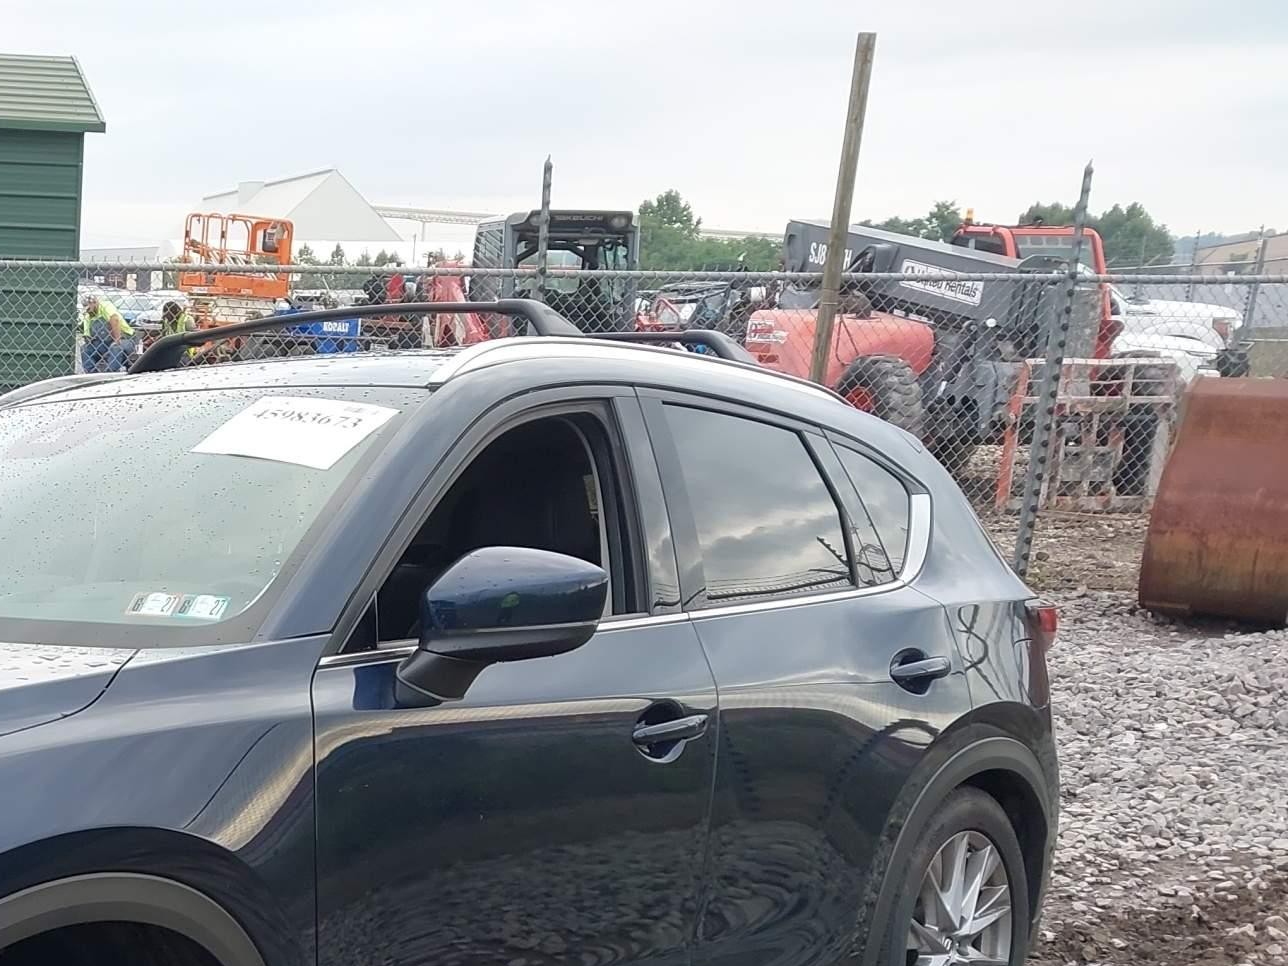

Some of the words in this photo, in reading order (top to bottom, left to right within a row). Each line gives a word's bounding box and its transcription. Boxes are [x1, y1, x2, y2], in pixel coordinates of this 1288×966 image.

[253, 409, 364, 429] 45983673
[160, 596, 177, 613] 27
[209, 599, 226, 616] 27
